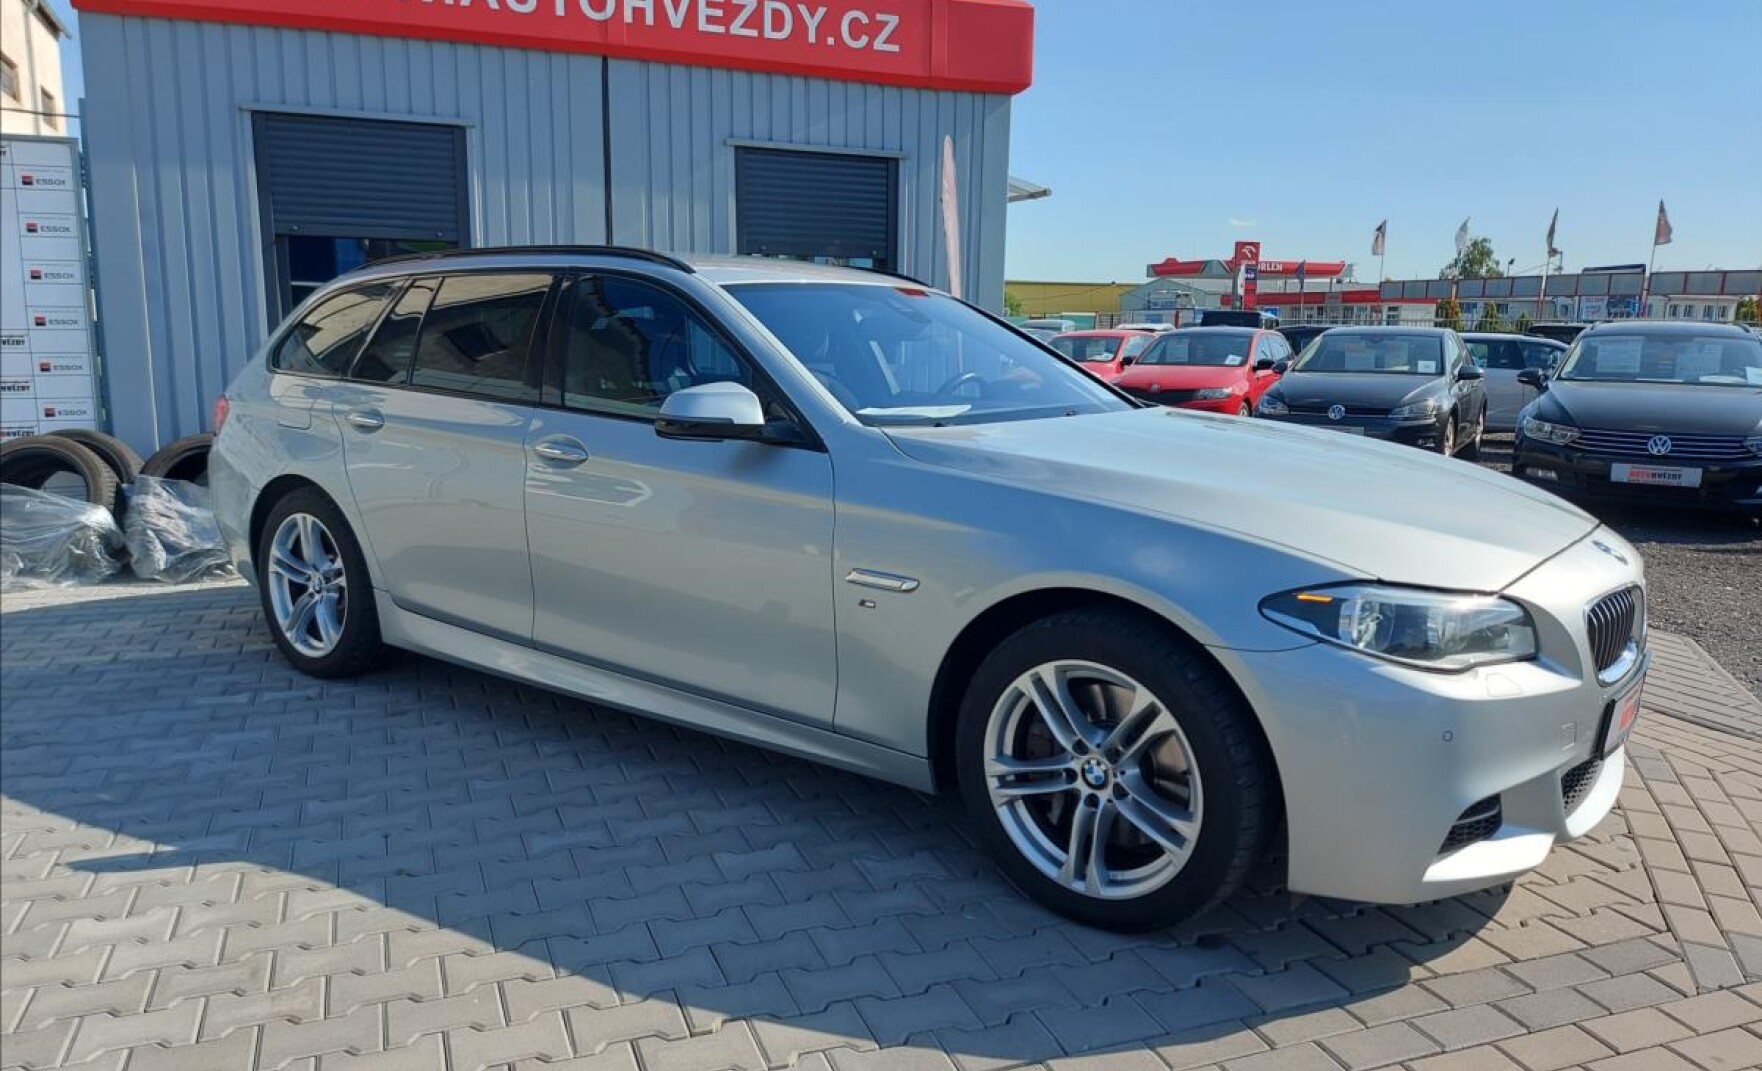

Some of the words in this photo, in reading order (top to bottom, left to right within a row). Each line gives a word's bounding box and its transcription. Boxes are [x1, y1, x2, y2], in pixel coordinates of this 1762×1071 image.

[422, 0, 900, 52] .OHVEZDY.CZ
[36, 178, 66, 186] ESSOX
[40, 225, 71, 233] ESSOX
